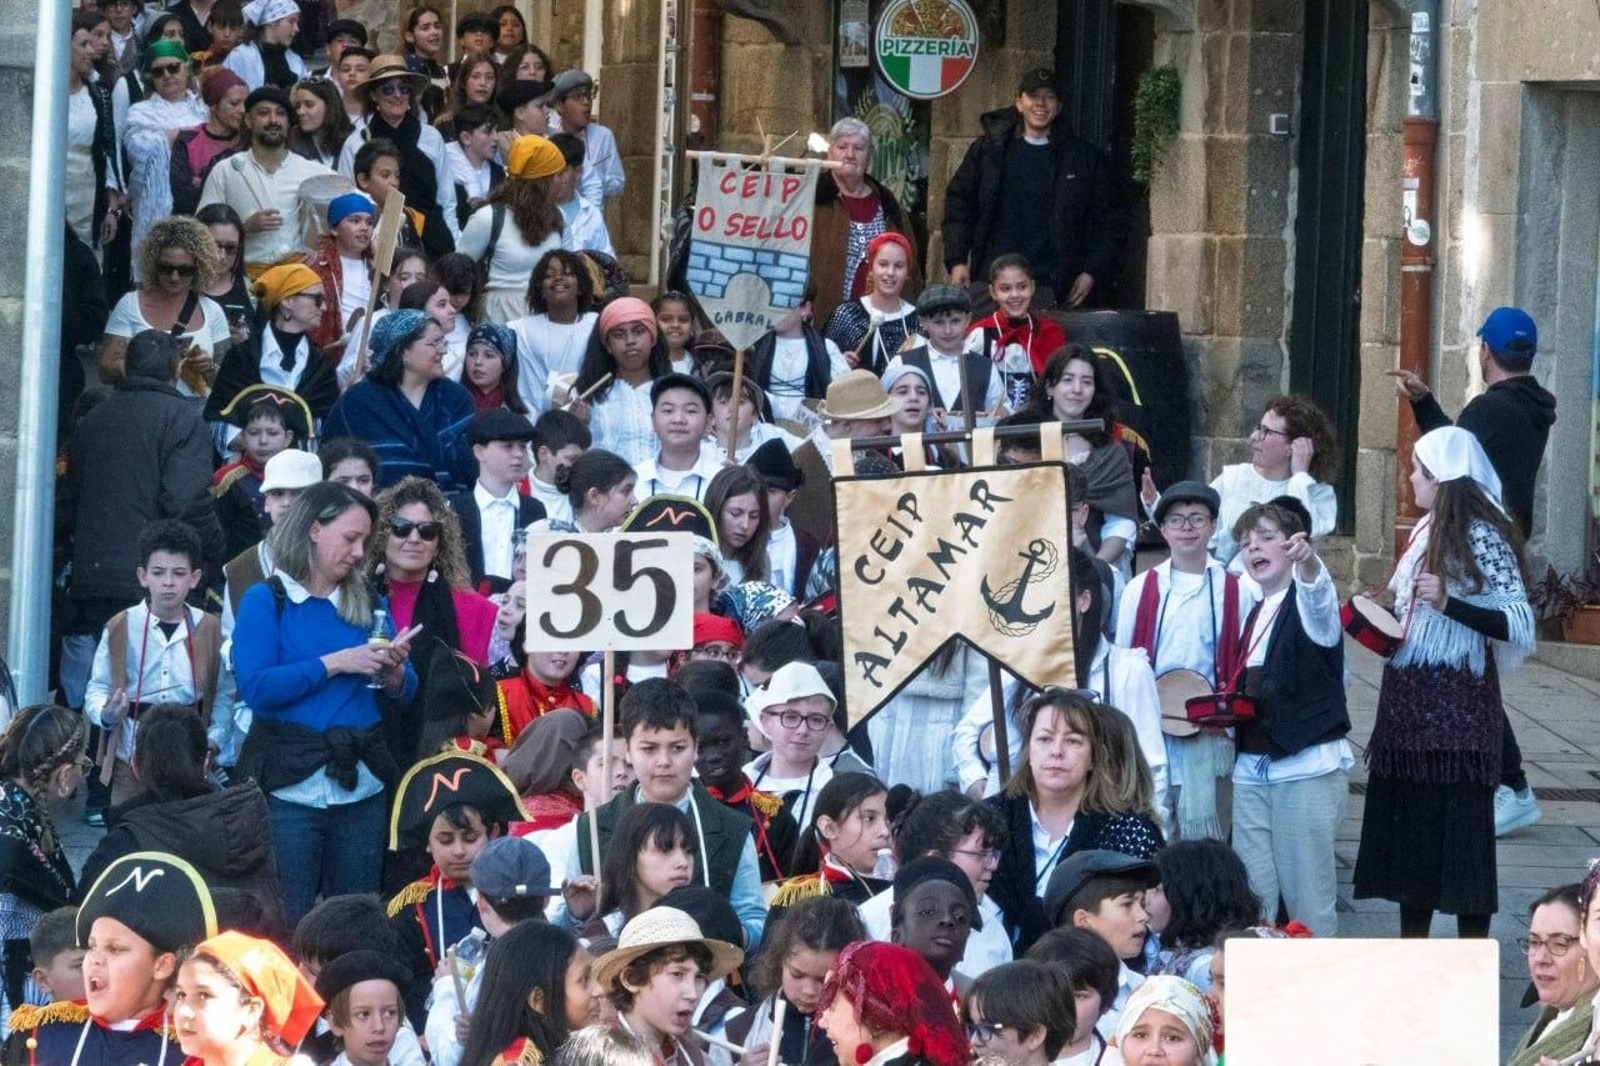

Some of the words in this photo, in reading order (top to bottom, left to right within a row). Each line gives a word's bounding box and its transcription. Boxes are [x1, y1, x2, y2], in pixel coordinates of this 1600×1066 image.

[883, 37, 971, 56] PIZZERÍA
[720, 171, 800, 203] CEIP
[698, 206, 716, 231] O
[724, 212, 808, 240] SELLO
[854, 491, 923, 584] CEIP
[539, 538, 677, 639] 35
[854, 479, 1014, 688] ALTAMAR
